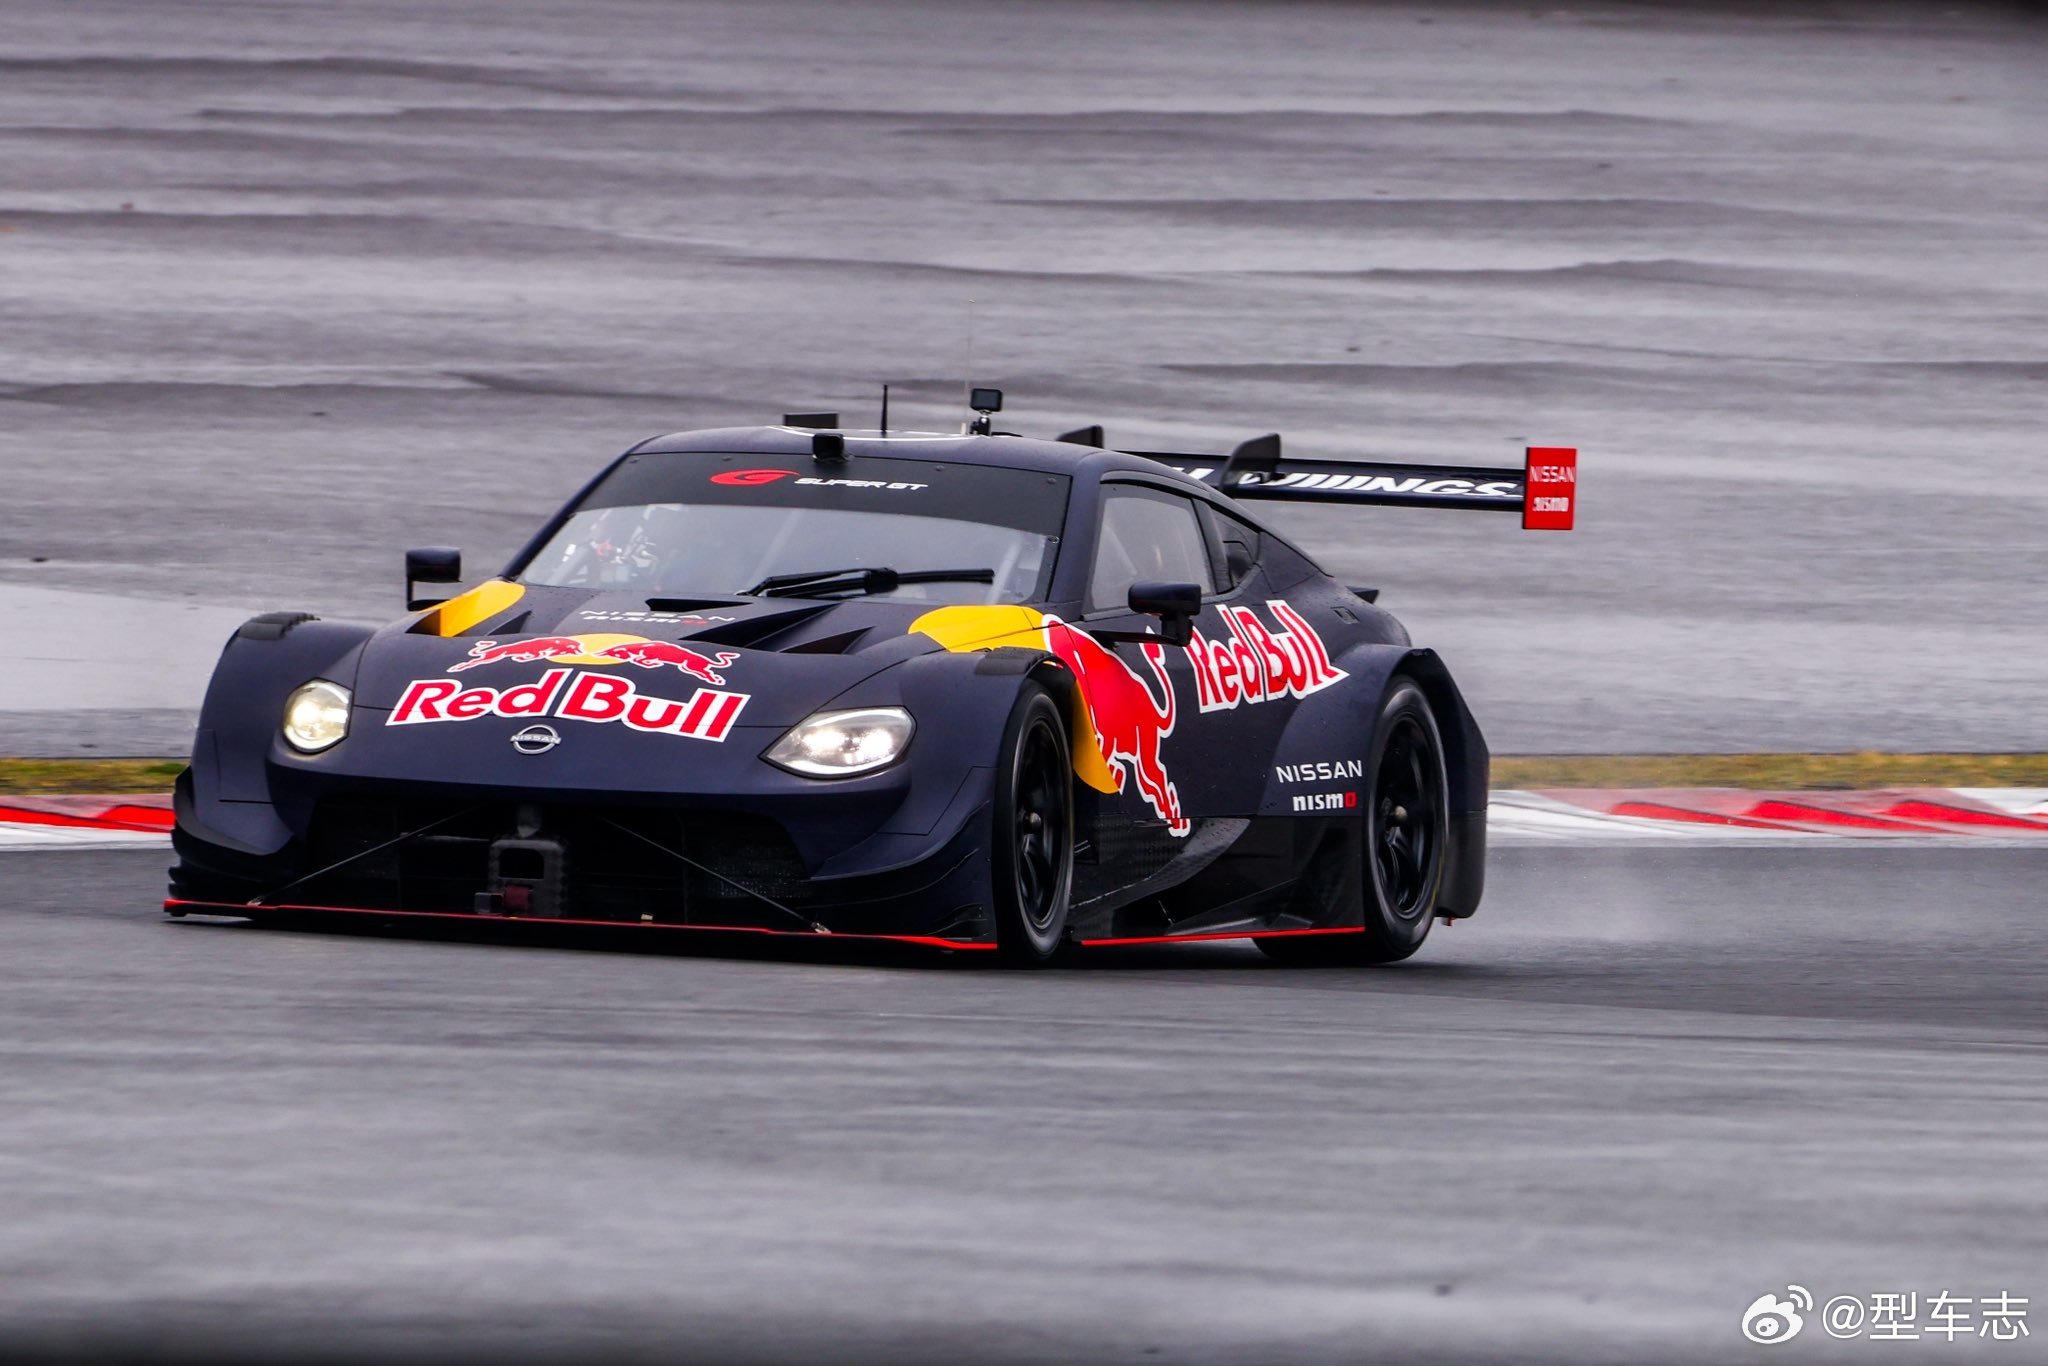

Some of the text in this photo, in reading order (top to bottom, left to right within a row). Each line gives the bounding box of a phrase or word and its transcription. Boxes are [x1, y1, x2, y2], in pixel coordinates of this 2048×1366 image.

[794, 477, 886, 488] SUPER
[886, 482, 929, 490] GT
[1530, 466, 1575, 482] NISSAN
[1184, 600, 1349, 713] Red Bull
[387, 669, 749, 741] Red Bull
[510, 734, 562, 744] NISSAN
[1275, 760, 1362, 783] NISSAN
[1293, 792, 1357, 811] nismo
